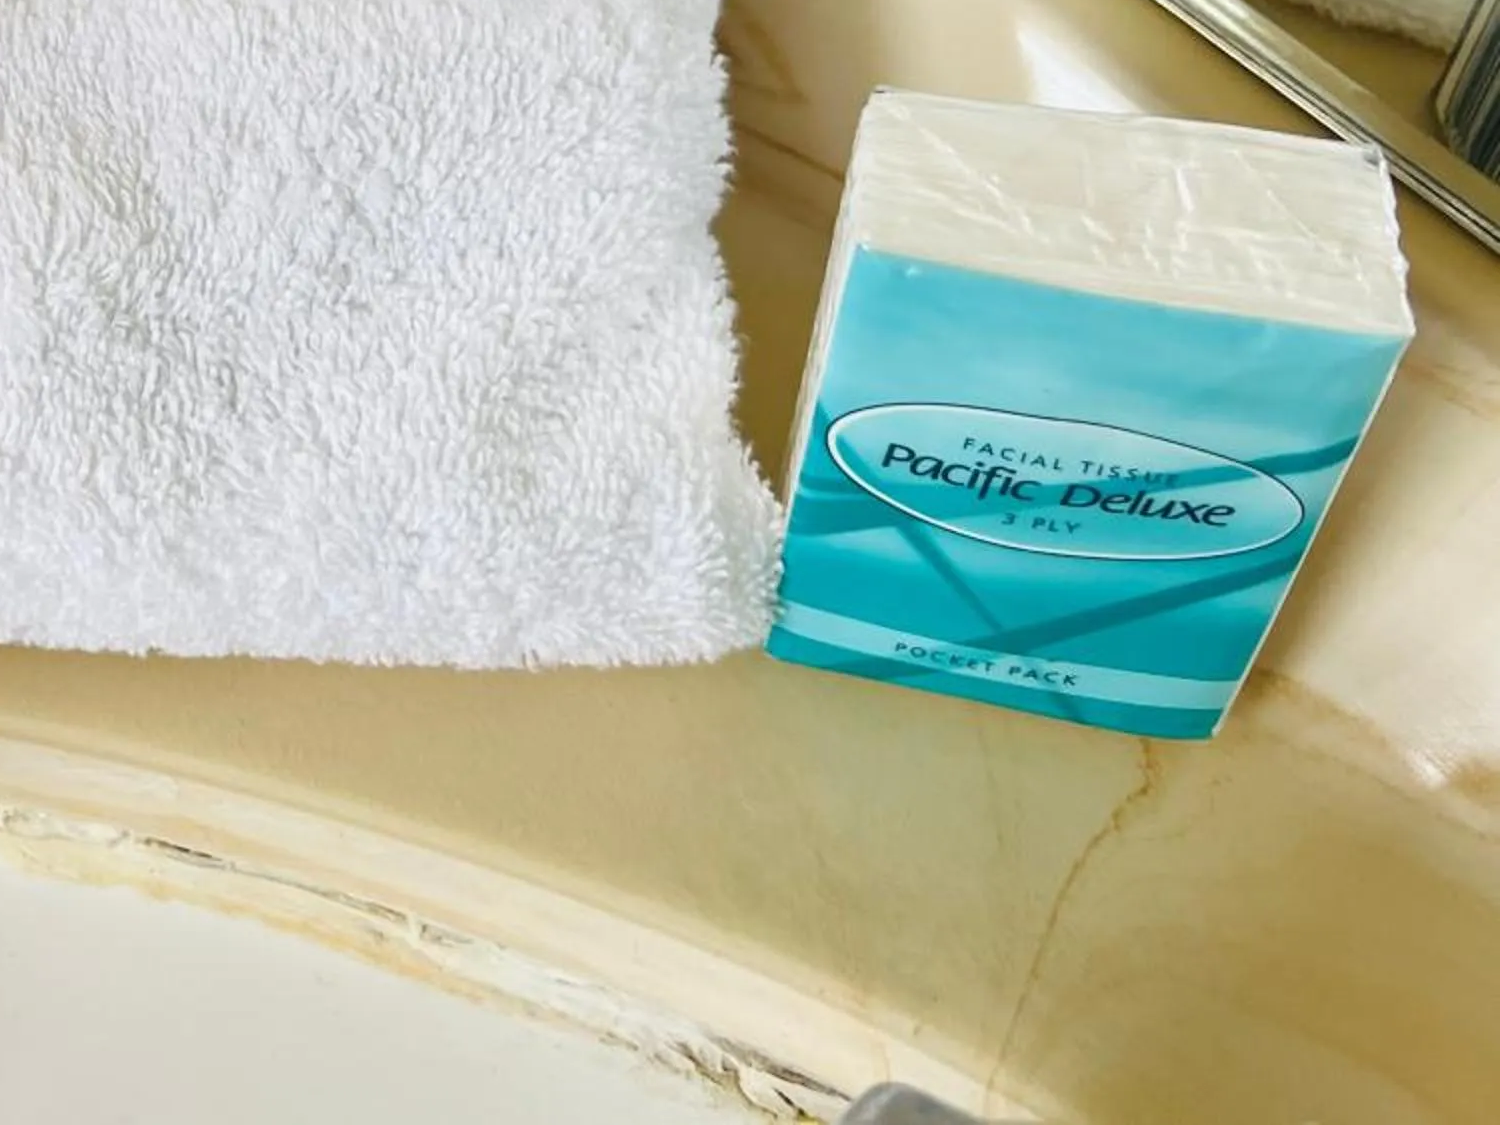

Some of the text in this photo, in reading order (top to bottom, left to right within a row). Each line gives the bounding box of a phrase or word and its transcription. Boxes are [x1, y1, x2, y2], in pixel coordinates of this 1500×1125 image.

[880, 441, 1237, 528] Pacific Deluxe
[962, 436, 1181, 486] FACIAL TISSUE
[1001, 511, 1084, 535] 3 PLY
[894, 641, 1079, 687] POCKET PACK
